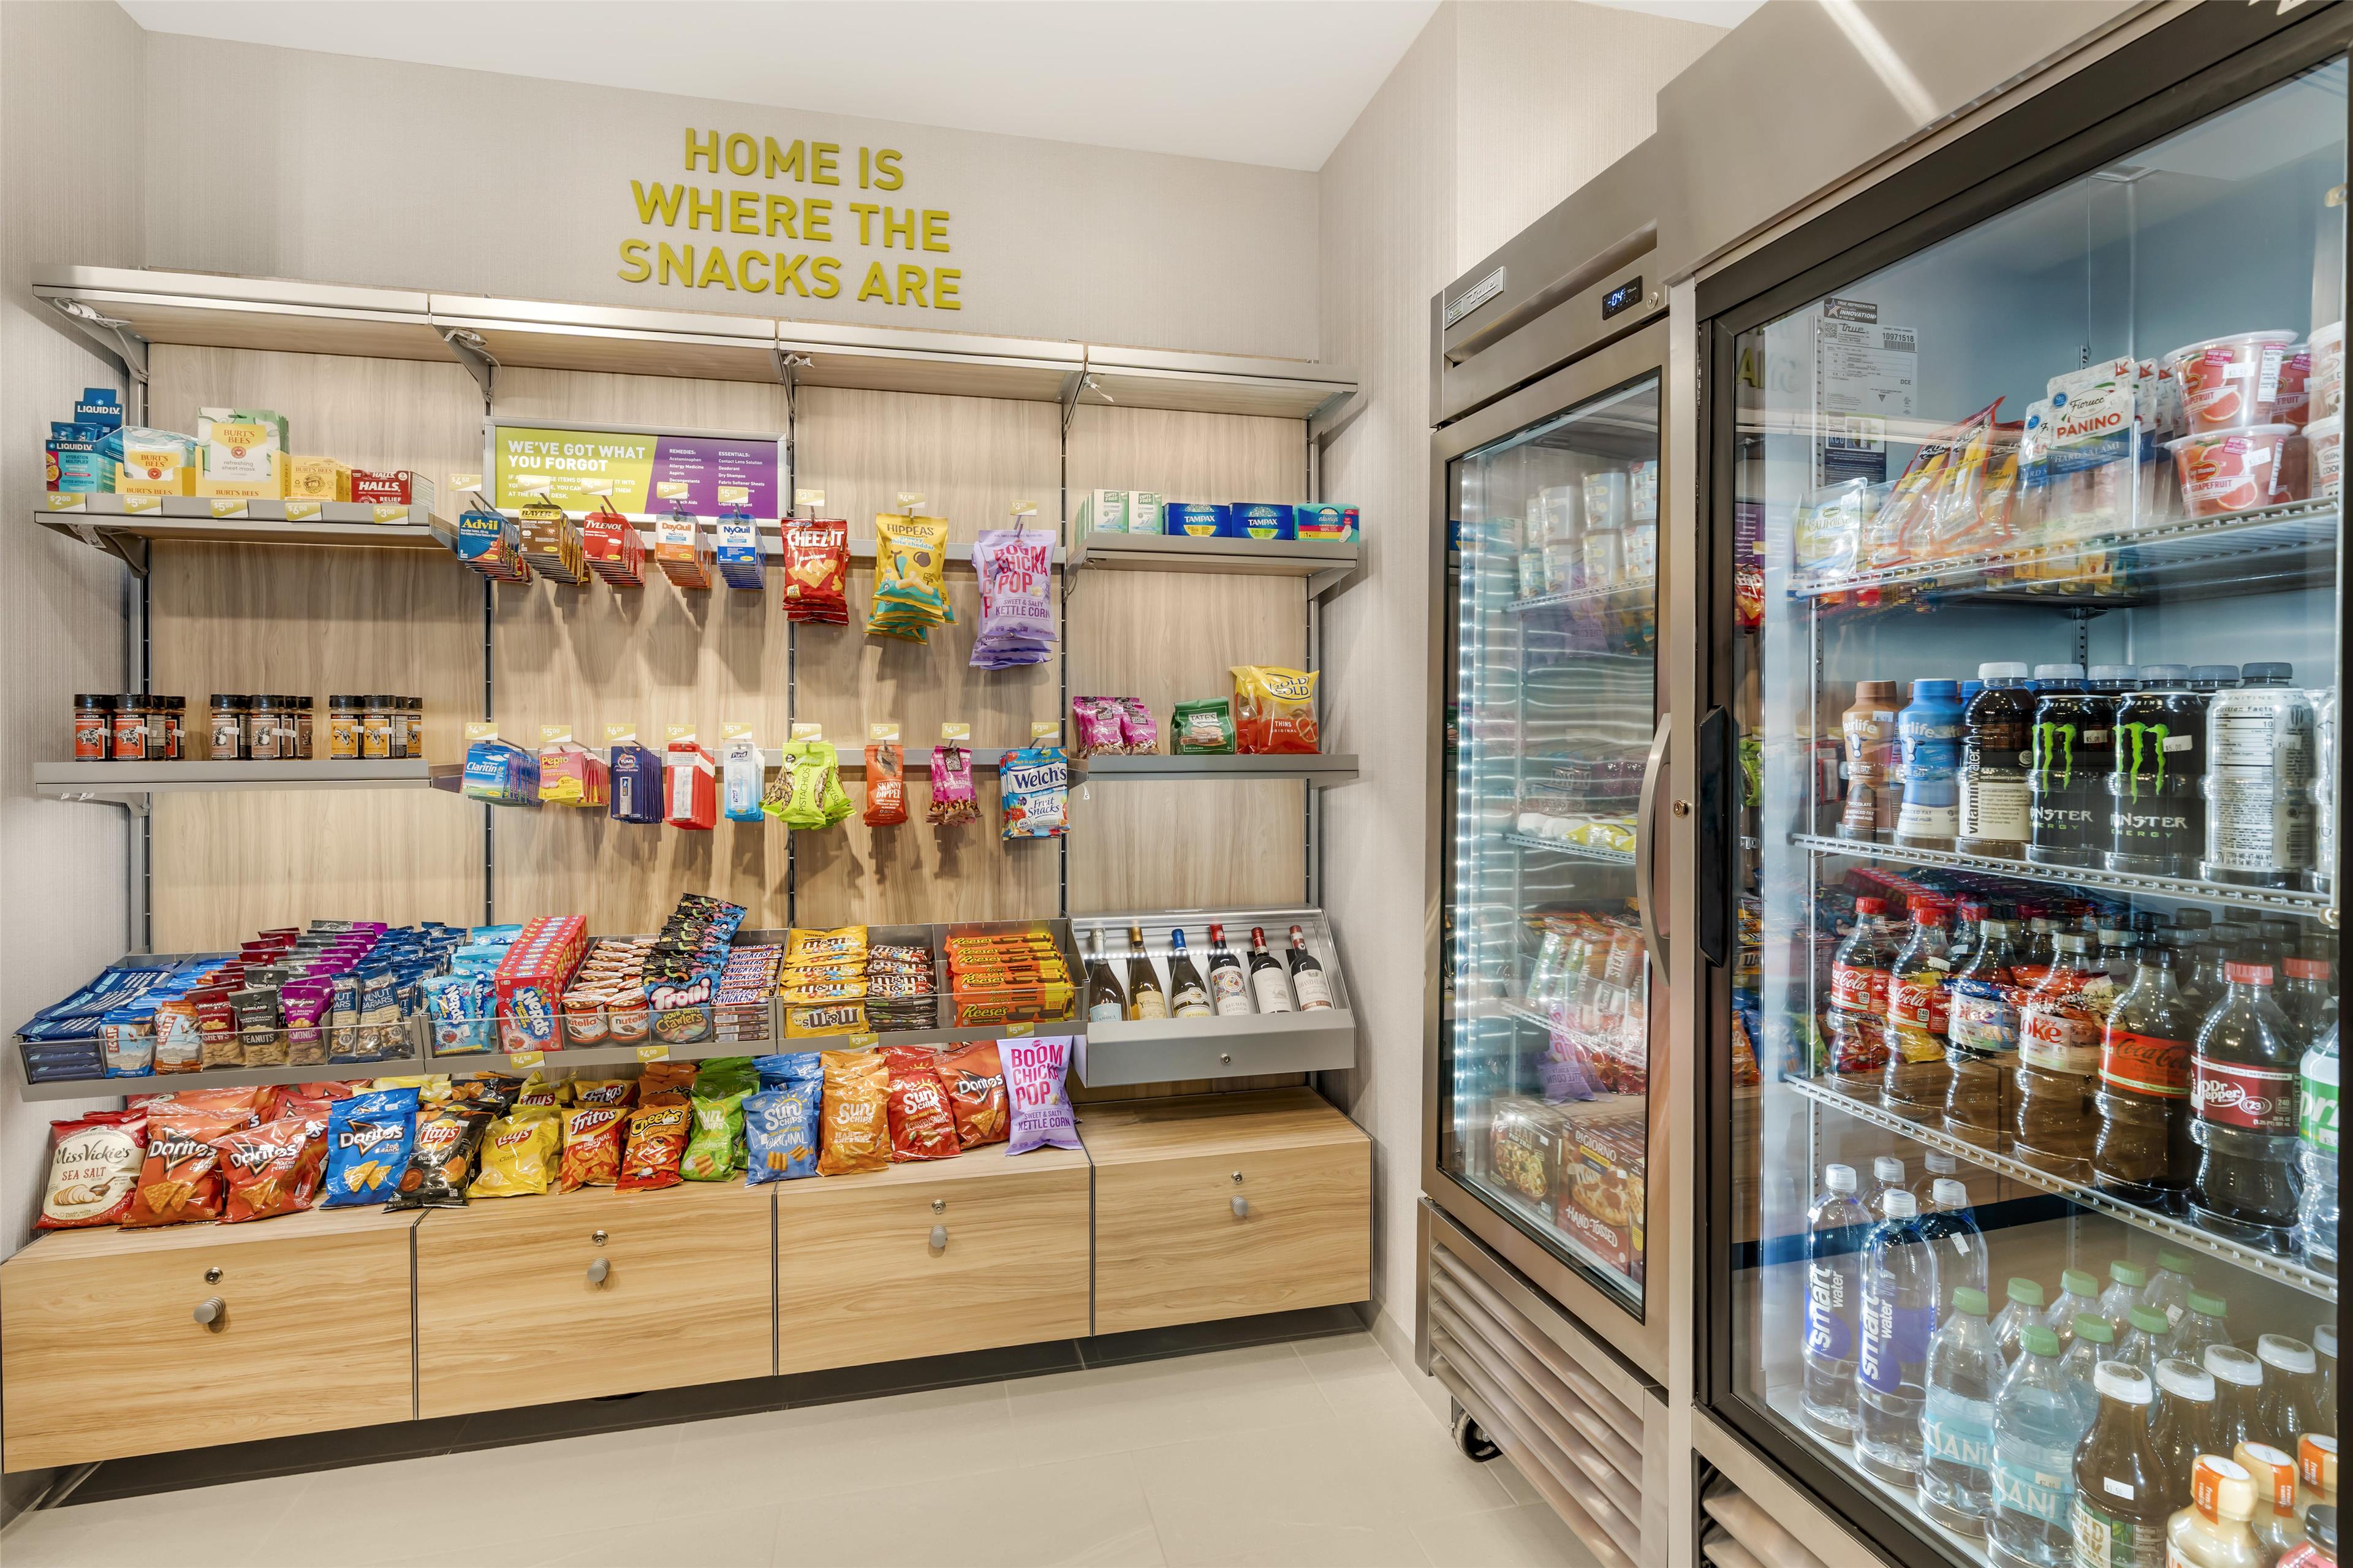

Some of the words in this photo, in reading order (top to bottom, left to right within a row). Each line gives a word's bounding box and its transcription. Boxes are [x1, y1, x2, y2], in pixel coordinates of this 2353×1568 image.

[685, 127, 840, 186] HOME
[859, 146, 904, 191] IS
[630, 180, 832, 241] WHERE
[849, 202, 949, 252] THE
[617, 238, 841, 298] SNACKS
[857, 261, 961, 310] ARE
[1840, 309, 1874, 319] INNOVATION
[1882, 333, 1914, 343] 10971518
[77, 405, 109, 414] LIQUID
[224, 429, 255, 437] BURT'S
[2056, 412, 2122, 439] PANINO
[508, 440, 559, 455] WE'VE
[563, 443, 594, 456] GOT
[598, 445, 645, 459] WHAT
[508, 455, 541, 469] YOU
[545, 457, 608, 472] FORGOT
[461, 518, 498, 531] Advil
[585, 520, 623, 531] TYLENOL
[1184, 514, 1216, 523] TAMPAX
[1248, 518, 1278, 526] TAMPAX
[1318, 514, 1339, 524] always
[662, 522, 691, 532] DayQuil
[724, 526, 751, 536] NyQuil
[887, 523, 934, 536] HIPPEAS
[907, 541, 934, 550] cheddar
[993, 544, 1047, 566] BOOM
[997, 555, 1049, 577] CHICKA
[997, 571, 1034, 595] POP
[995, 605, 1026, 616] KETTLE
[1028, 606, 1051, 619] CORN
[466, 762, 498, 773] Claritin
[541, 756, 569, 766] Pepto
[1012, 767, 1067, 789] Welch's
[798, 767, 811, 812] PISTACHIOS
[876, 782, 902, 792] SKINNY
[876, 789, 901, 798] DIPPED
[1033, 797, 1055, 808] Fruit
[1028, 805, 1060, 819] Snacks
[951, 936, 994, 945] Reese's
[730, 950, 770, 961] SNICKERS
[960, 955, 1002, 964] Reese's
[962, 975, 1006, 985] Reese's
[650, 978, 713, 1010] Trolli
[713, 992, 756, 1004] SNICKERS
[615, 1012, 650, 1025] nutella
[961, 1004, 1009, 1018] Reese's
[656, 1012, 703, 1033] Crawlers
[1010, 1044, 1063, 1069] BOOM
[1013, 1065, 1060, 1086] CHICKA
[958, 1073, 1003, 1095] Doritos
[2211, 1080, 2226, 1093] Dr
[1016, 1088, 1050, 1111] POP
[2199, 1080, 2242, 1104] Pepper
[903, 1089, 939, 1115] Sun
[2249, 1102, 2262, 1110] 23
[764, 1104, 803, 1131] Sun
[779, 1116, 803, 1126] CHIPS
[838, 1102, 876, 1125] Sun
[850, 1115, 873, 1124] CHIPS
[570, 1110, 616, 1134] Fritos
[631, 1108, 683, 1135] Cheetos
[1017, 1119, 1048, 1130] KETTLE
[1048, 1118, 1070, 1129] CORN
[339, 1123, 404, 1149] Doritos
[420, 1125, 459, 1144] Lay's
[496, 1129, 532, 1149] Lay's
[583, 1133, 611, 1147] ORIGINAL
[766, 1131, 808, 1149] ORIGINAL
[81, 1140, 131, 1163] Vickie's
[149, 1140, 218, 1159] Doritos
[1575, 1131, 1617, 1162] DIGIORNO
[230, 1143, 297, 1168] Doritos
[62, 1169, 80, 1181] SEA
[83, 1166, 107, 1180] SALT
[1566, 1205, 1618, 1248] HAND-TOSSED
[1809, 1263, 1832, 1350] smart
[1831, 1270, 1844, 1308] water
[1862, 1287, 1880, 1381] smart
[1881, 1298, 1893, 1339] water
[2105, 1483, 2123, 1496] $3.50
